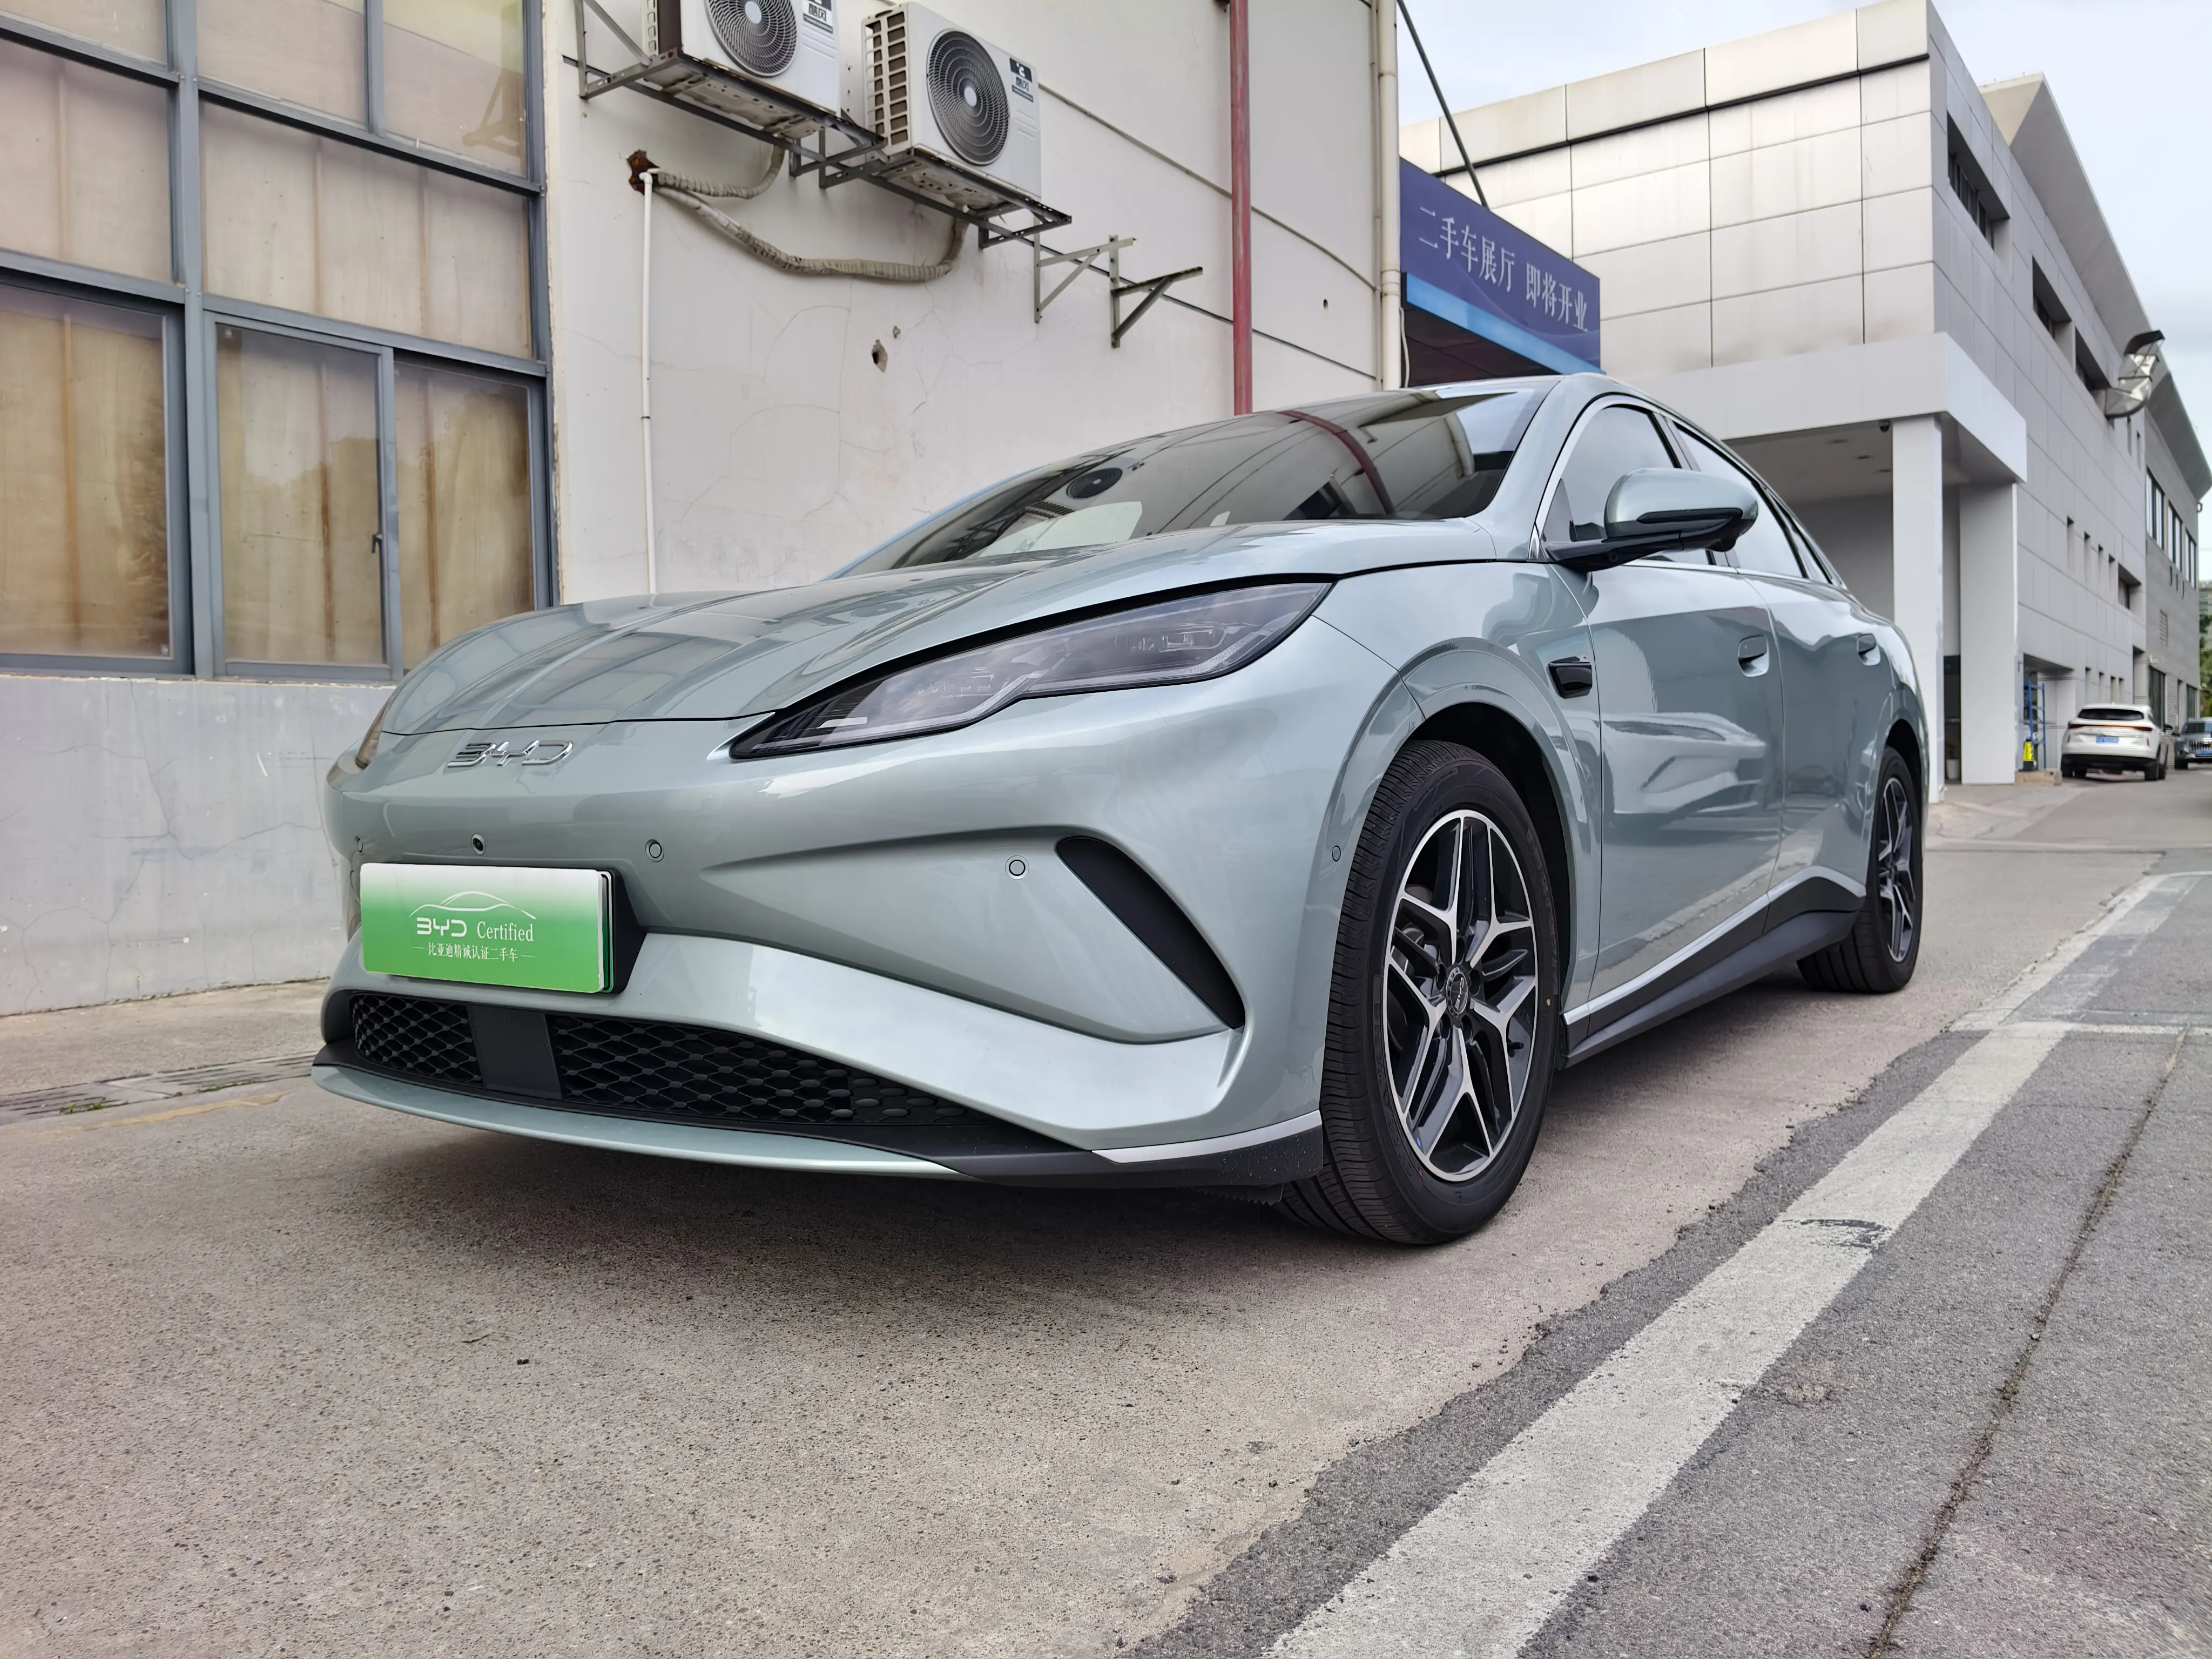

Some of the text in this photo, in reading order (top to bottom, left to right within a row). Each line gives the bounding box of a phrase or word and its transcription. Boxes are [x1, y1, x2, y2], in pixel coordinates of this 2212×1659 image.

[1419, 206, 1588, 333] 二手车展厅 即将开业
[447, 740, 573, 767] BYD
[417, 917, 534, 941] BYD Certified
[428, 942, 518, 962] 比亚迪精诚认证二手车
